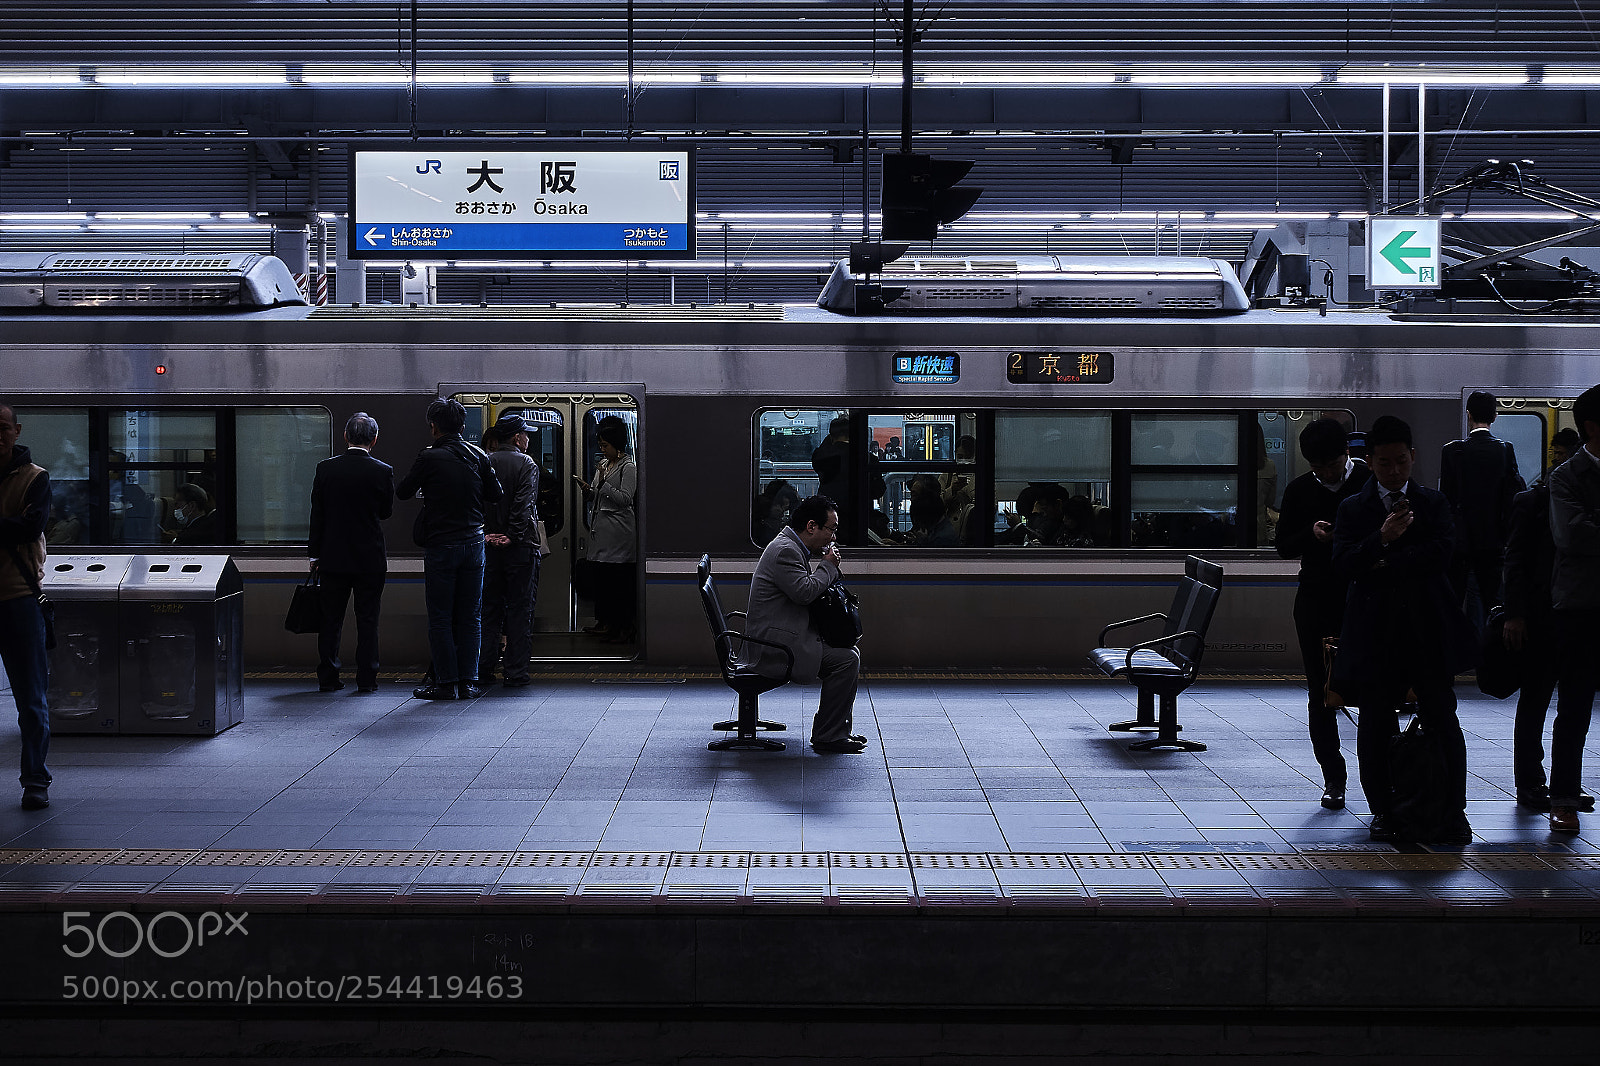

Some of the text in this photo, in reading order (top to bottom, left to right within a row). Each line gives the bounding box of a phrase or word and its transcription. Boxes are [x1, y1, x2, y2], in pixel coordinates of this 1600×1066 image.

[416, 160, 441, 174] JR
[456, 202, 516, 215] おおさか
[534, 198, 588, 215] Ōsaka
[392, 227, 452, 239] しんおおさか
[624, 227, 668, 239] つかもと
[624, 238, 666, 246] Tsukamoto
[912, 356, 955, 374] 新快速
[1012, 354, 1022, 369] 2
[1039, 354, 1099, 375] 京都
[198, 719, 211, 729] JR
